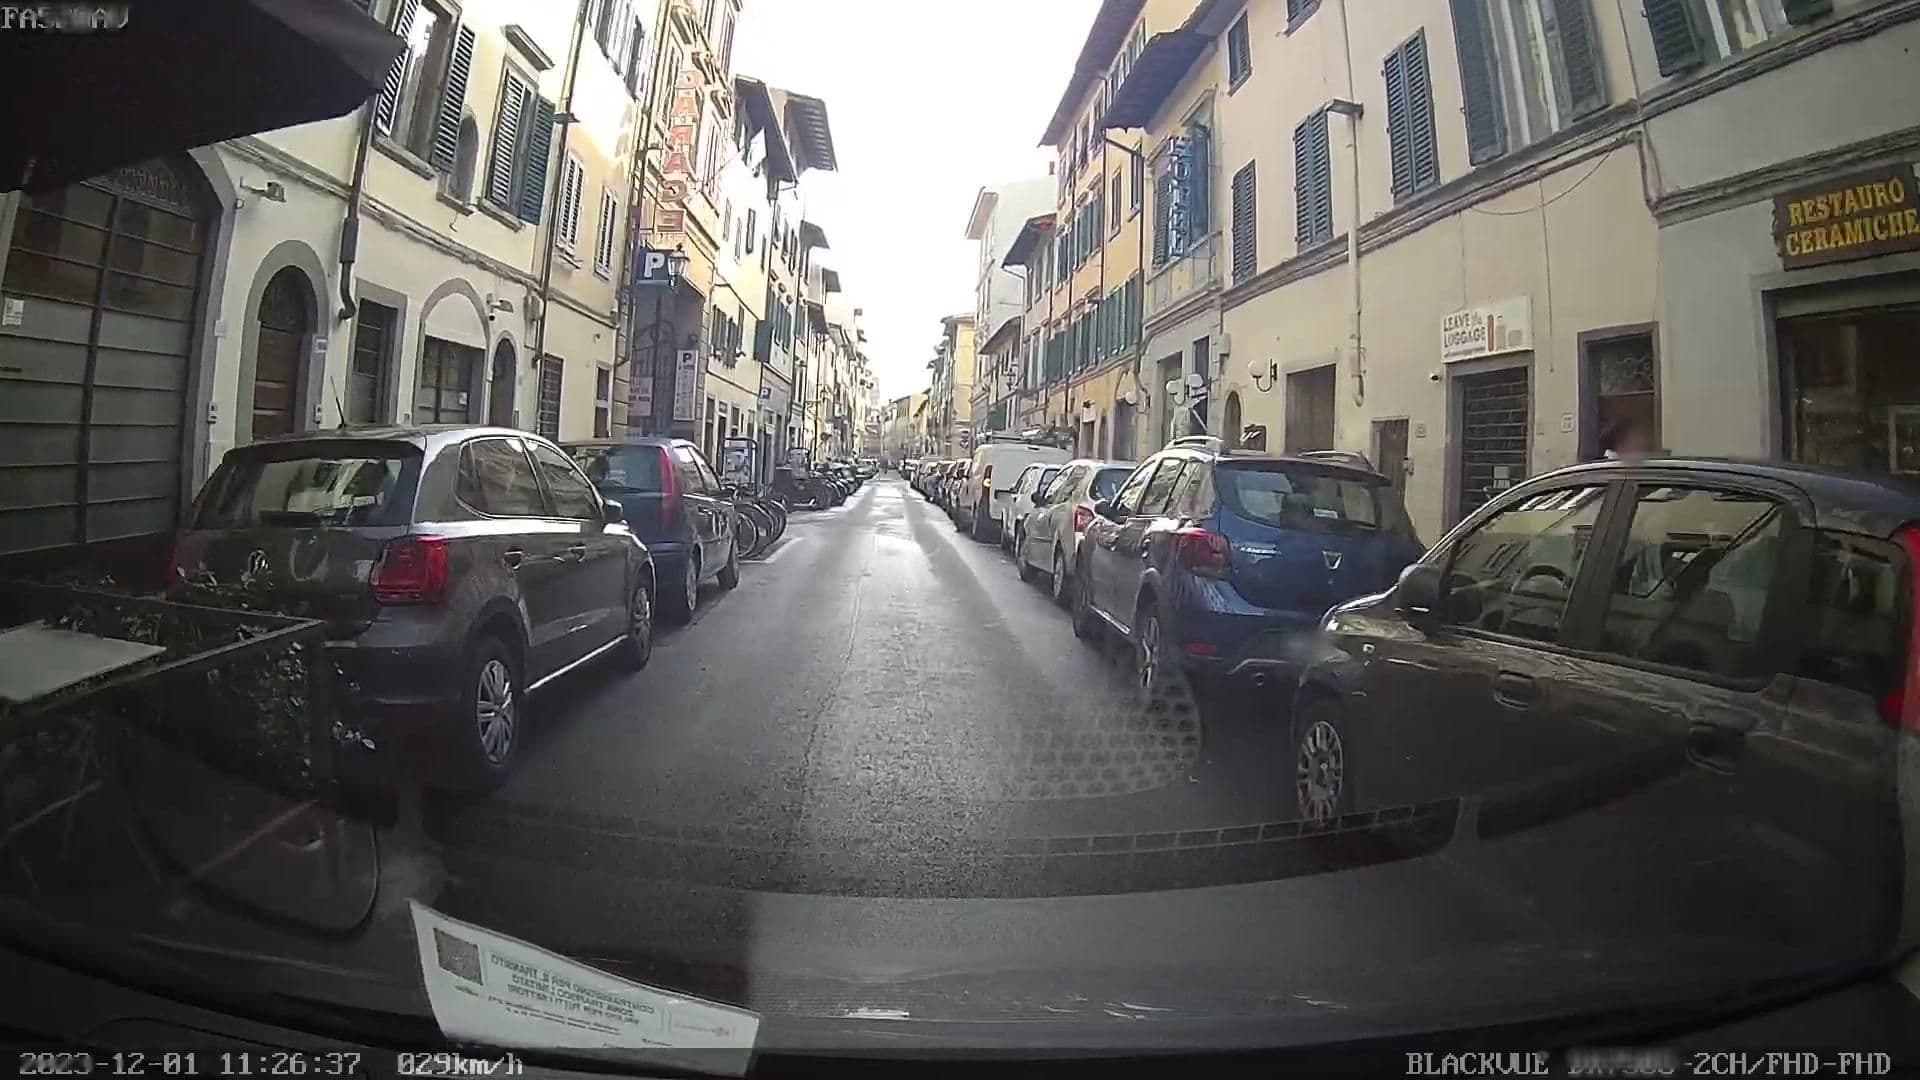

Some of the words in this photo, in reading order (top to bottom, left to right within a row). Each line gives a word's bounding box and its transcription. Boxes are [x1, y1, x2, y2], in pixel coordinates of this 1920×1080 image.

[1788, 177, 1905, 226] RESTAURO
[1786, 209, 1920, 256] CERAMICHE
[644, 252, 665, 279] P
[1443, 313, 1470, 332] LEAVE
[1443, 327, 1486, 348] LUGGAGE
[683, 352, 692, 363] P
[760, 388, 769, 398] P
